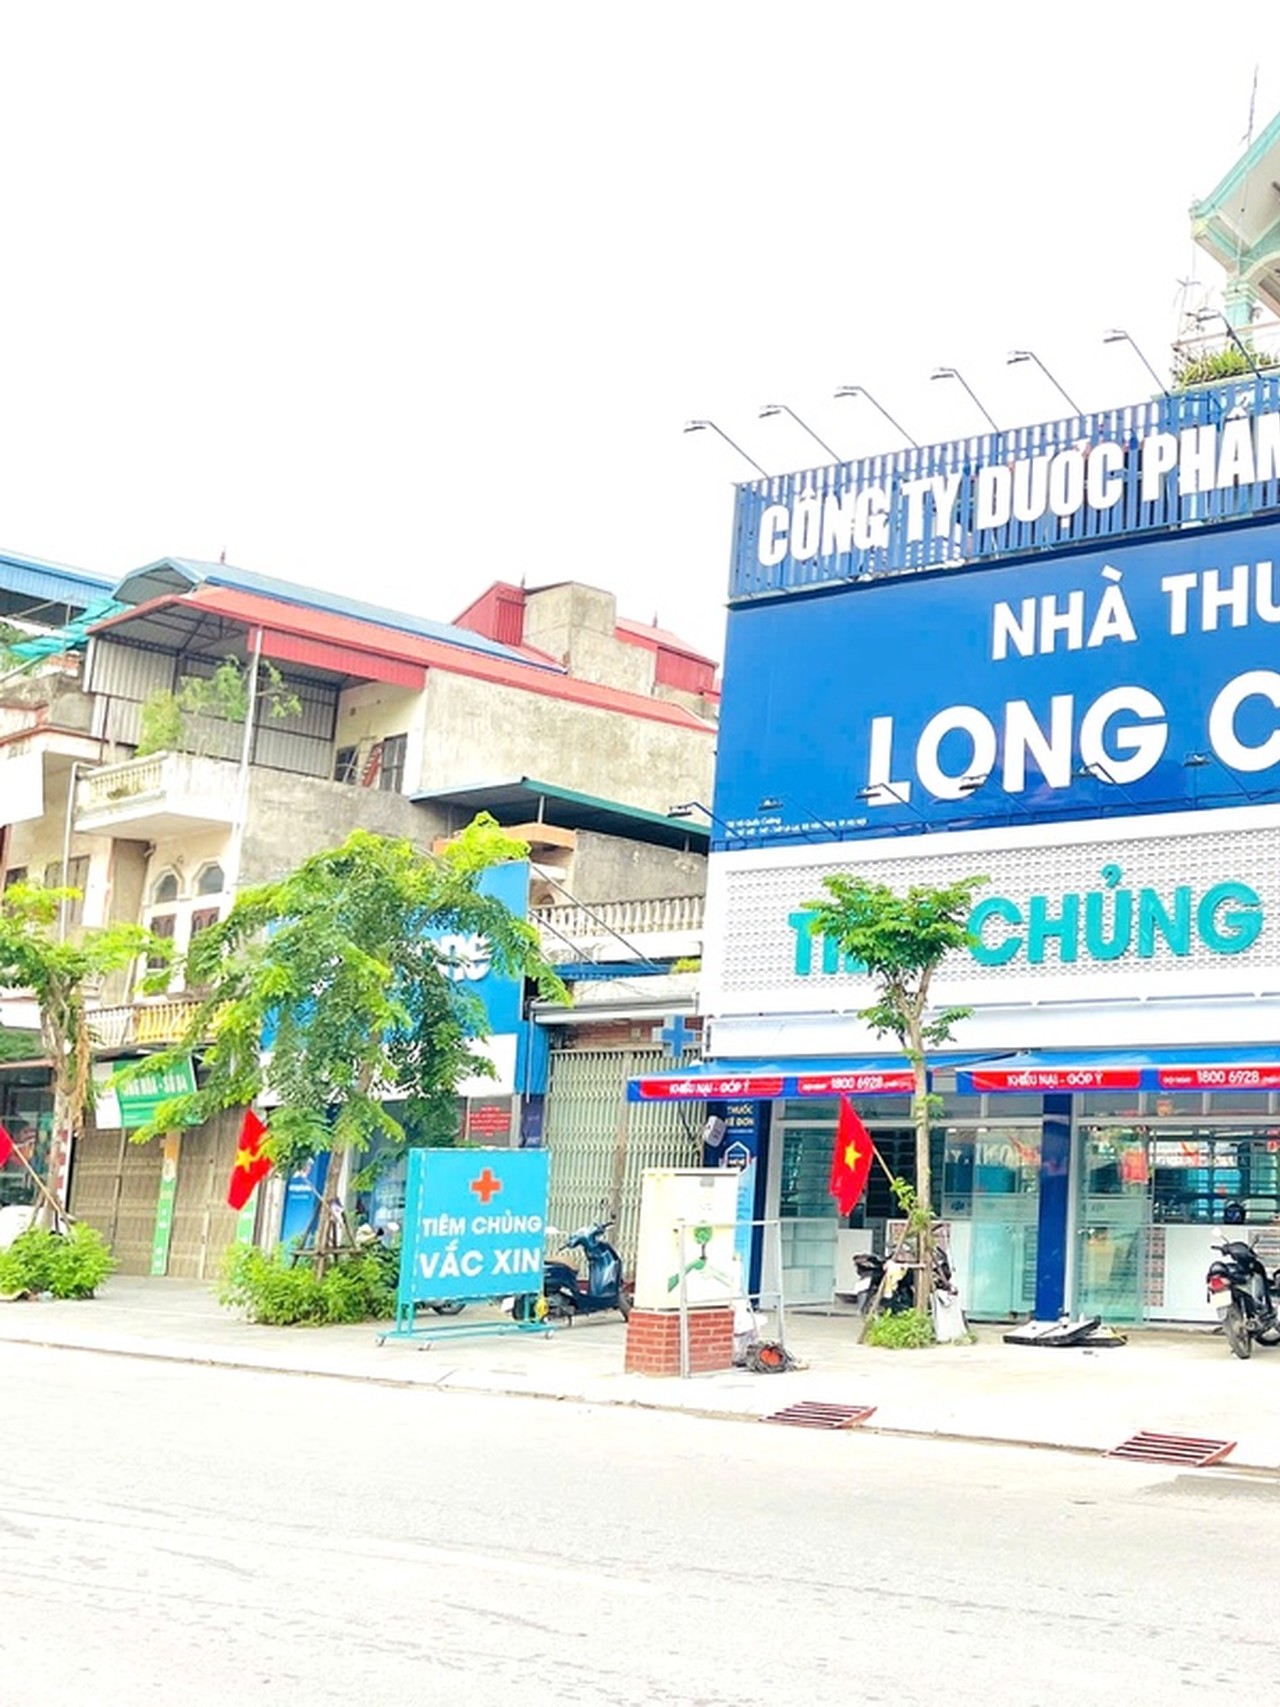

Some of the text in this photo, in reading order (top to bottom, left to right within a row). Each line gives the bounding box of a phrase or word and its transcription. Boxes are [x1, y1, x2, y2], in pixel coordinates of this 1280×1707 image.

[758, 487, 889, 566] CÔNG
[900, 469, 965, 543] TY
[976, 439, 1123, 529] DƯỢC
[992, 565, 1138, 661] NHÀ
[867, 685, 1169, 807] LONG
[965, 864, 1264, 967] CHỦNG
[831, 1076, 855, 1089] 1800
[857, 1075, 883, 1089] 6928
[1196, 1070, 1226, 1084] 1800
[1228, 1070, 1260, 1084] 6928
[422, 1210, 542, 1237] TIÊM CHỦNG
[419, 1239, 541, 1279] VẮC XIN
